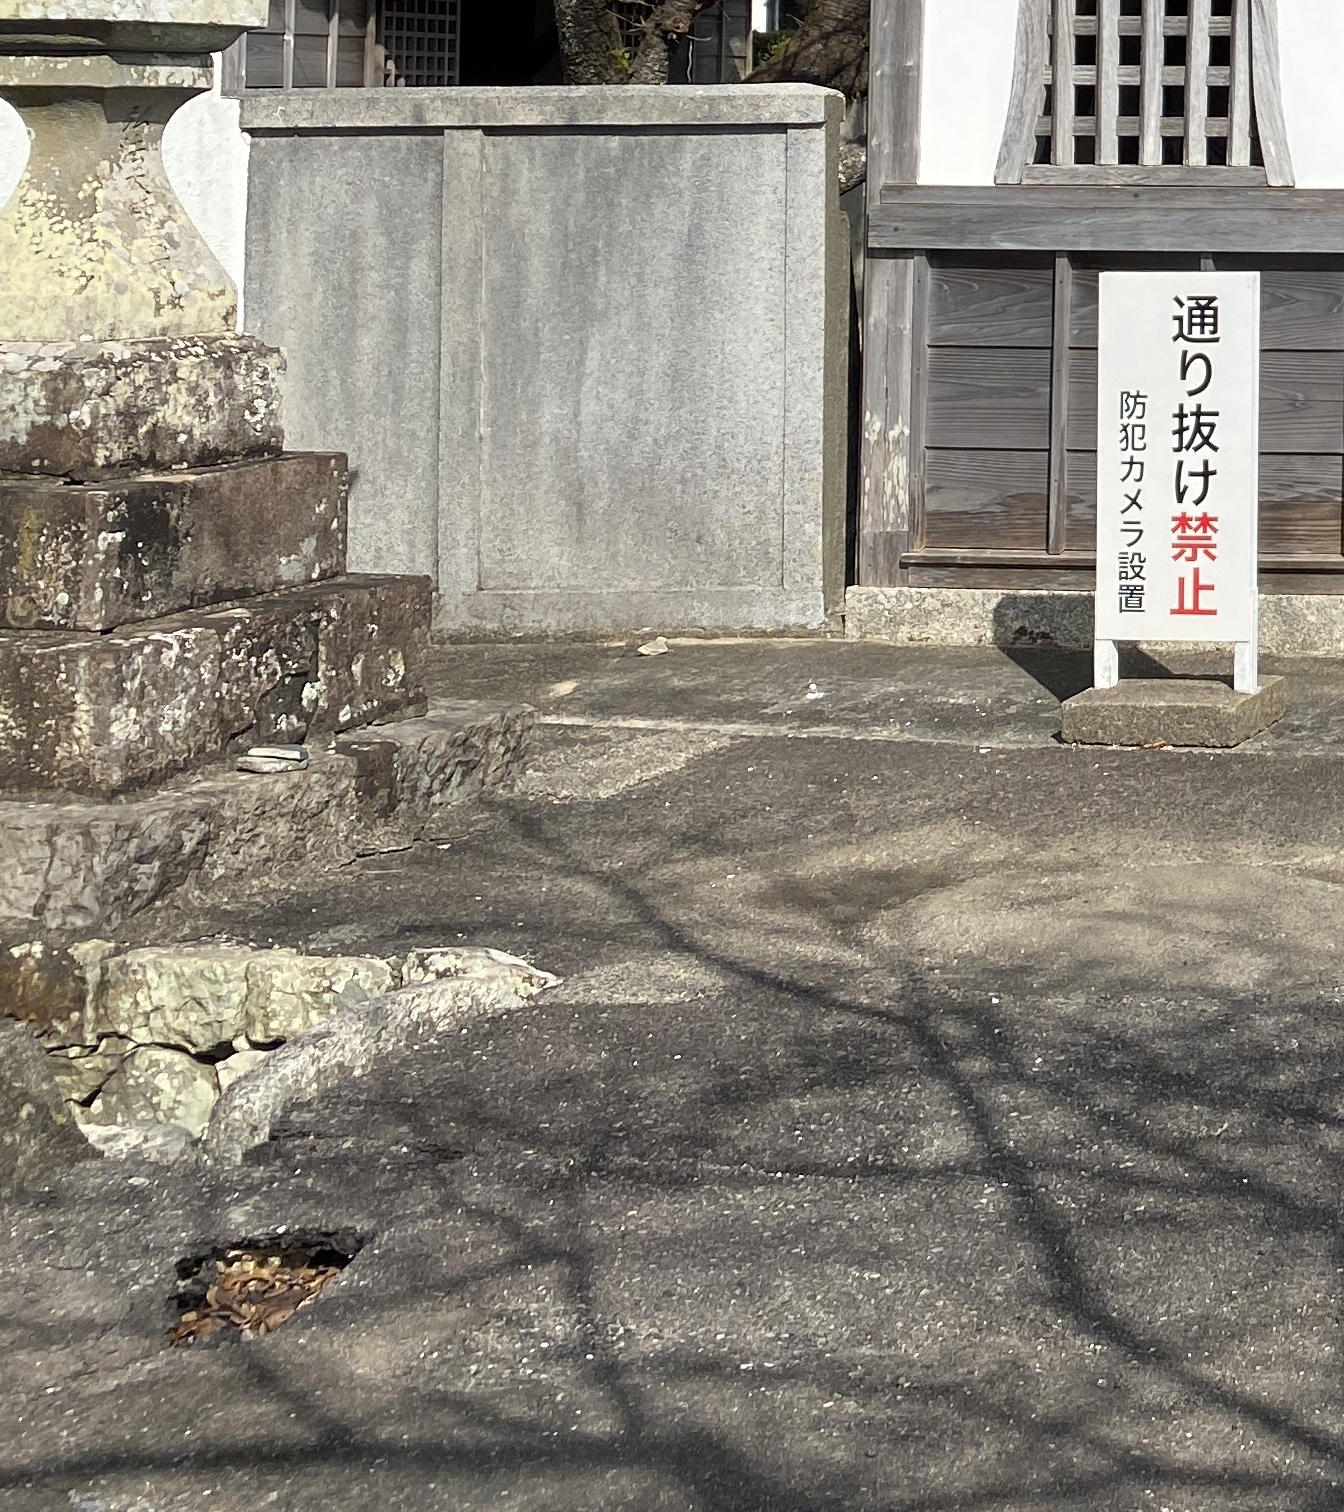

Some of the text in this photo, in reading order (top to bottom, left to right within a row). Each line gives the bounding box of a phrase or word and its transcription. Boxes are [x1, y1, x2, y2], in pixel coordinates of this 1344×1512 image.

[1119, 391, 1147, 614] 防犯カメラ設置
[1170, 295, 1221, 616] 通り抜け禁止
